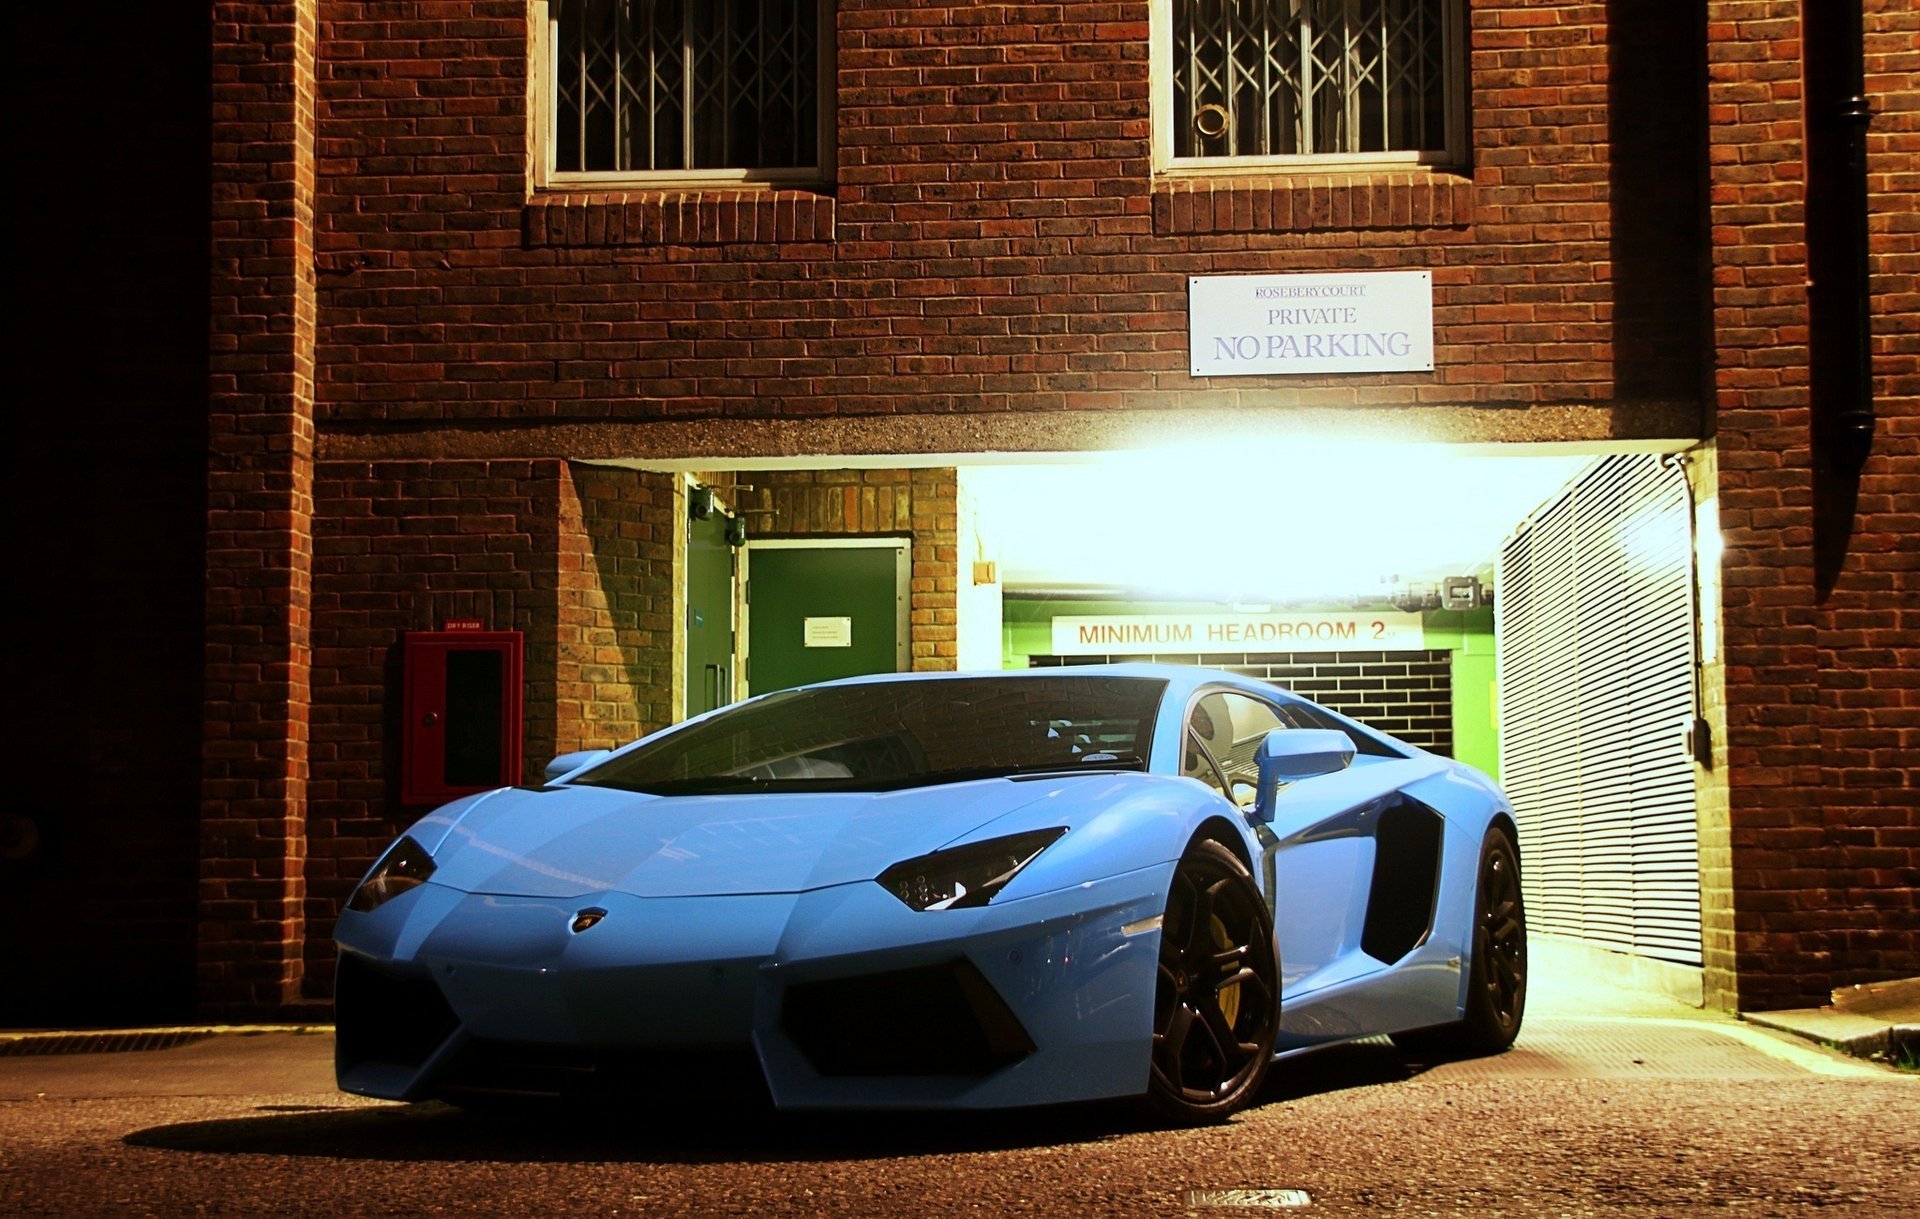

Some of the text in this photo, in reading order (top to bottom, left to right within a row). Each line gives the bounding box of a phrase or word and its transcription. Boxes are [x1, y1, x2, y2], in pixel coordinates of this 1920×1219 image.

[1255, 285, 1366, 299] ROSEBERY COURT
[1268, 307, 1357, 325] PRIVATE
[1213, 332, 1412, 360] NO PARKING
[1079, 623, 1193, 644] MINIMUM
[1207, 621, 1356, 643] HEADROOM
